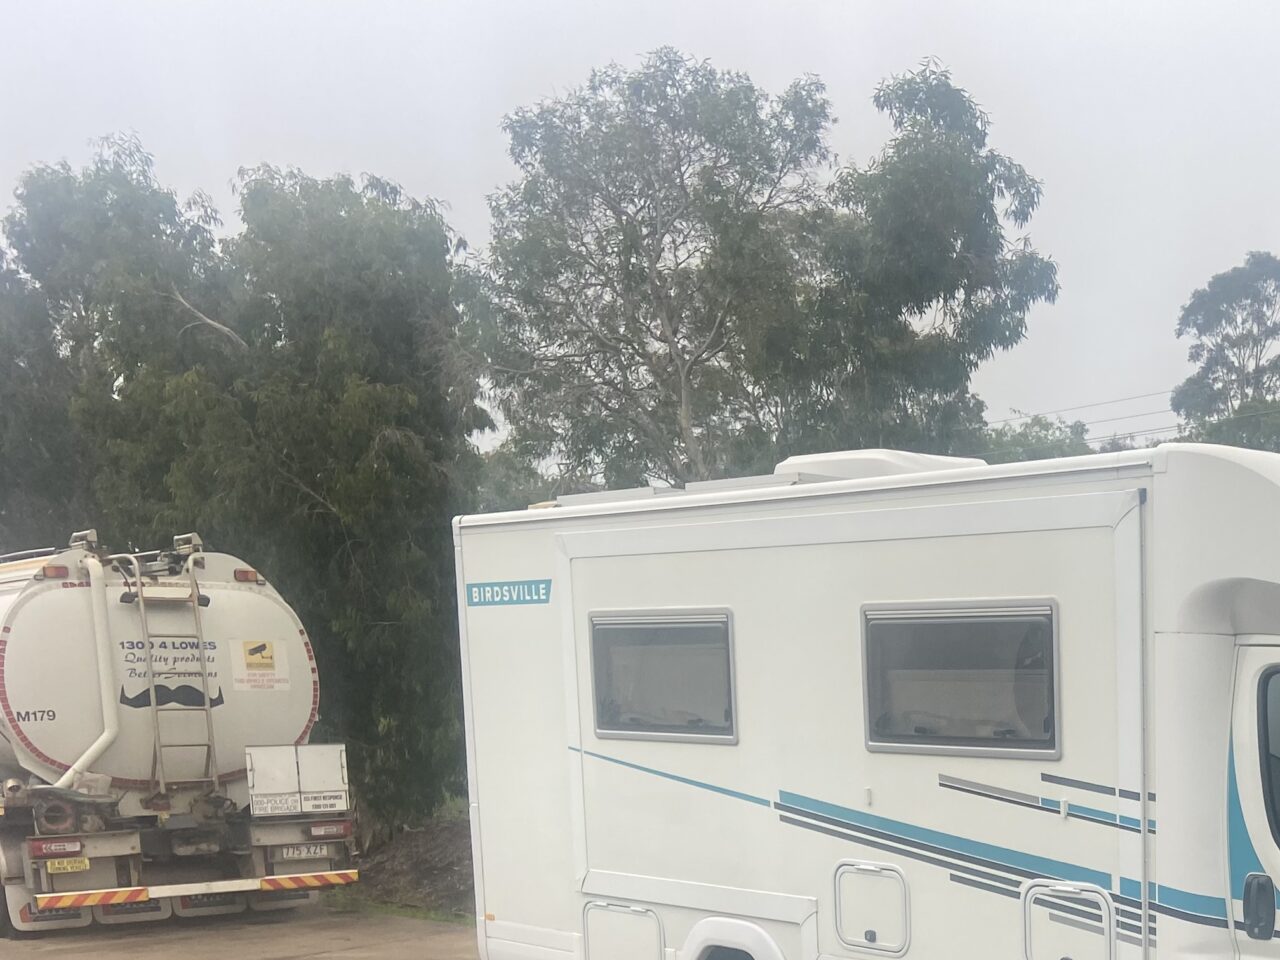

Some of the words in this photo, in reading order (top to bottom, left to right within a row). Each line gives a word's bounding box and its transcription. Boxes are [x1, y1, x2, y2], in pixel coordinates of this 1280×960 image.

[472, 584, 547, 602] BIRDSVILLE
[159, 641, 168, 650] 4
[16, 709, 56, 722] M179
